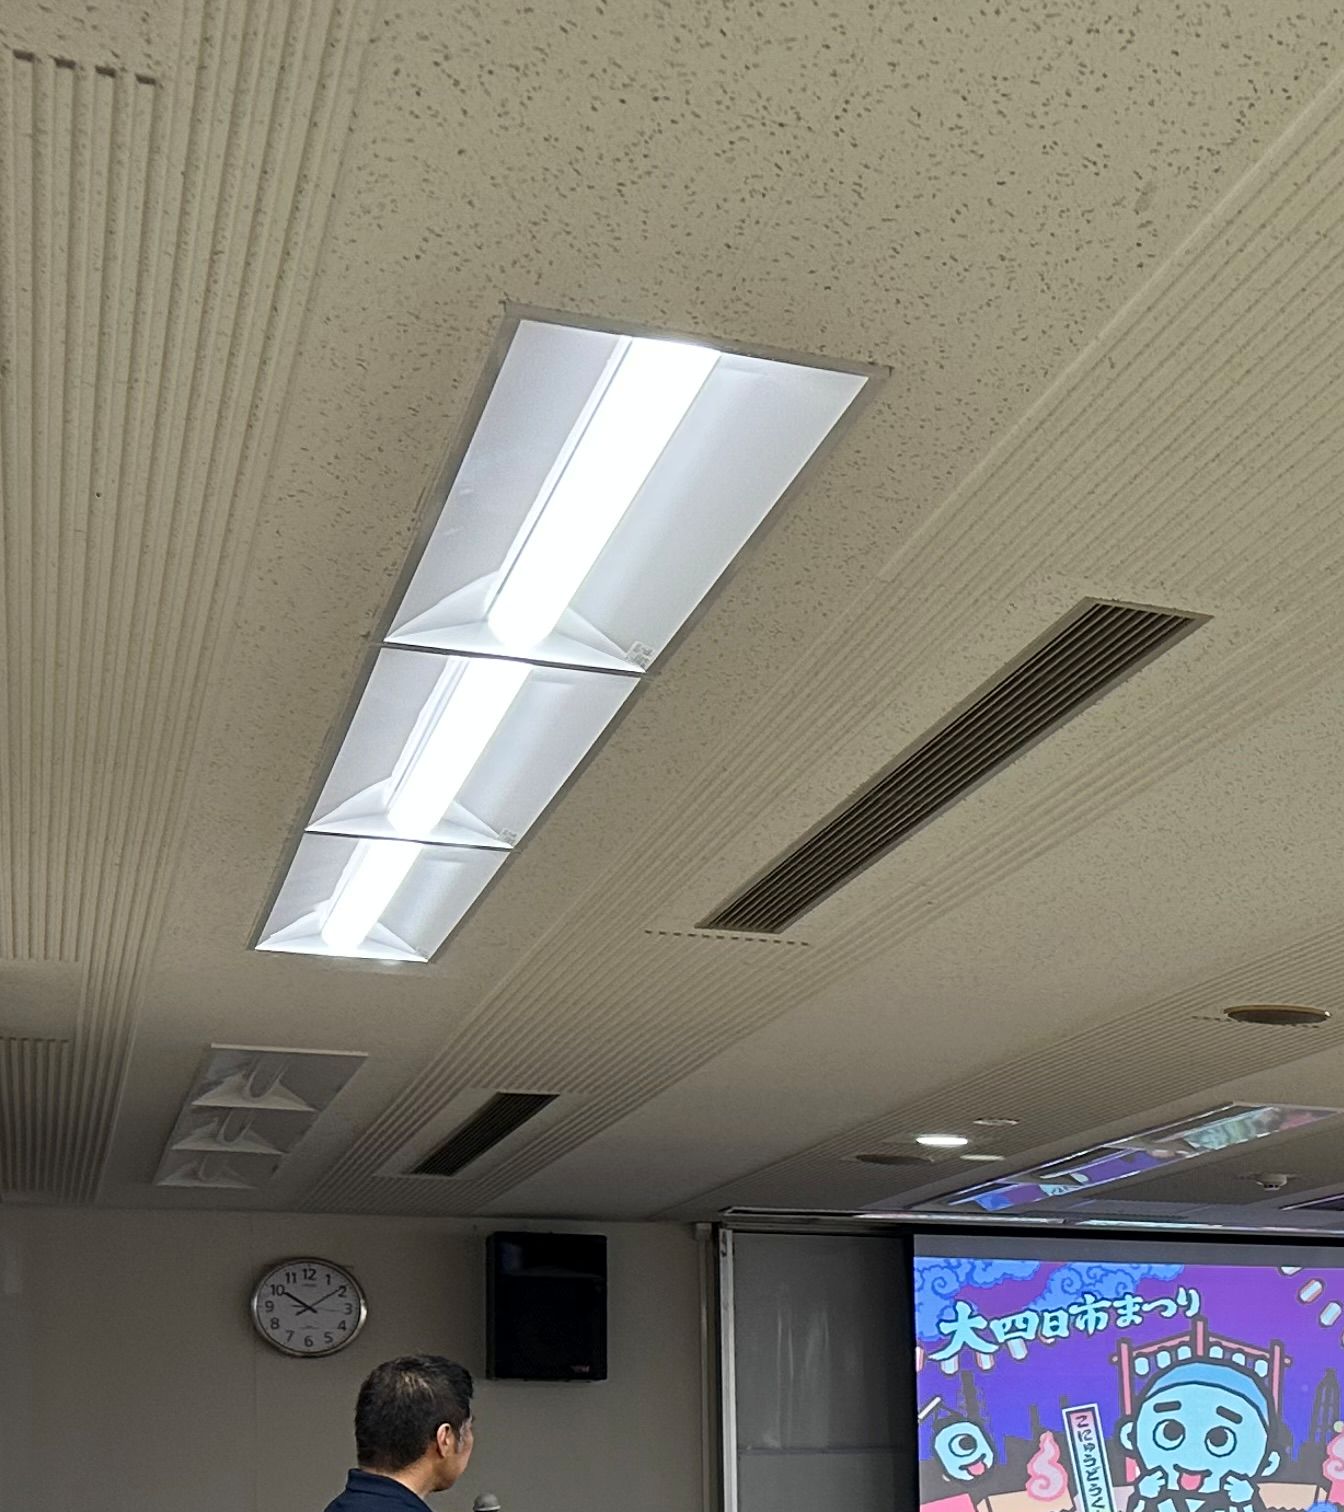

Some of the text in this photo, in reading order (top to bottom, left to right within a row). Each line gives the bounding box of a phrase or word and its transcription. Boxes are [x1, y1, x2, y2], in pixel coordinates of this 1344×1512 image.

[285, 1272, 297, 1284] 11
[302, 1268, 317, 1281] 12
[326, 1273, 331, 1285] 1
[270, 1284, 285, 1296] 10
[338, 1285, 347, 1298] 2
[265, 1300, 274, 1312] 9
[344, 1302, 353, 1315] 3
[270, 1317, 280, 1330] 8
[337, 1320, 346, 1331] 4
[928, 1287, 1201, 1362] 大四日市まつり
[285, 1330, 295, 1343] 7
[304, 1335, 313, 1348] 6
[324, 1331, 334, 1344] 5
